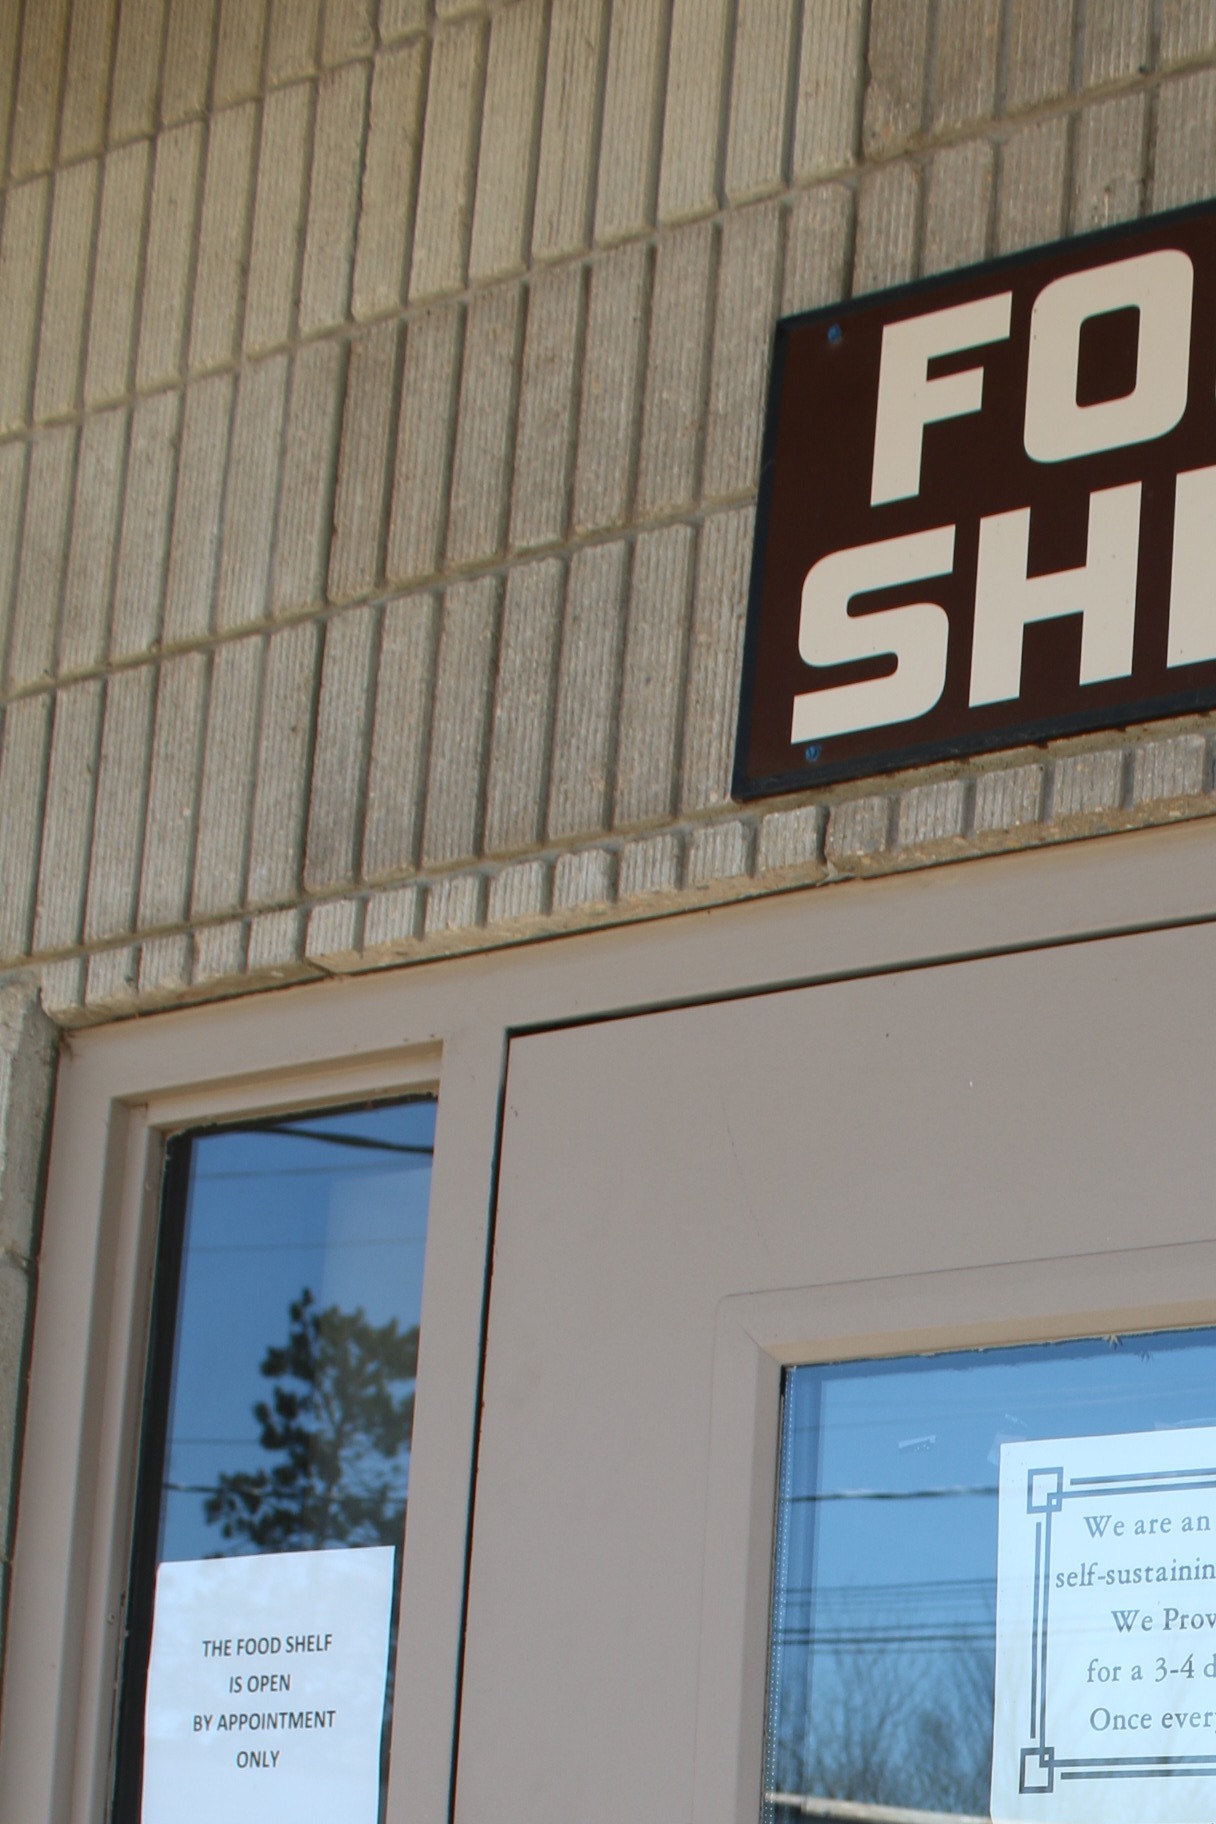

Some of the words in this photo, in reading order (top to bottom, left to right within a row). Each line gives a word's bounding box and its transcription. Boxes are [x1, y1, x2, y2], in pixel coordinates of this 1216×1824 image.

[1083, 1514, 1125, 1539] We
[1134, 1514, 1172, 1535] are
[1181, 1513, 1211, 1533] an
[1111, 1608, 1153, 1633] We
[202, 1638, 232, 1657] THE
[236, 1636, 282, 1656] FOOD
[285, 1633, 333, 1653] SHELF
[1087, 1658, 1122, 1684] for
[1130, 1662, 1144, 1681] a
[1154, 1653, 1195, 1682] 3-4
[229, 1676, 242, 1693] IS
[247, 1674, 291, 1692] OPEN
[192, 1714, 214, 1732] BY
[216, 1710, 336, 1731] APPOINTMENT
[1089, 1707, 1152, 1732] Once
[236, 1750, 280, 1768] ONLY
